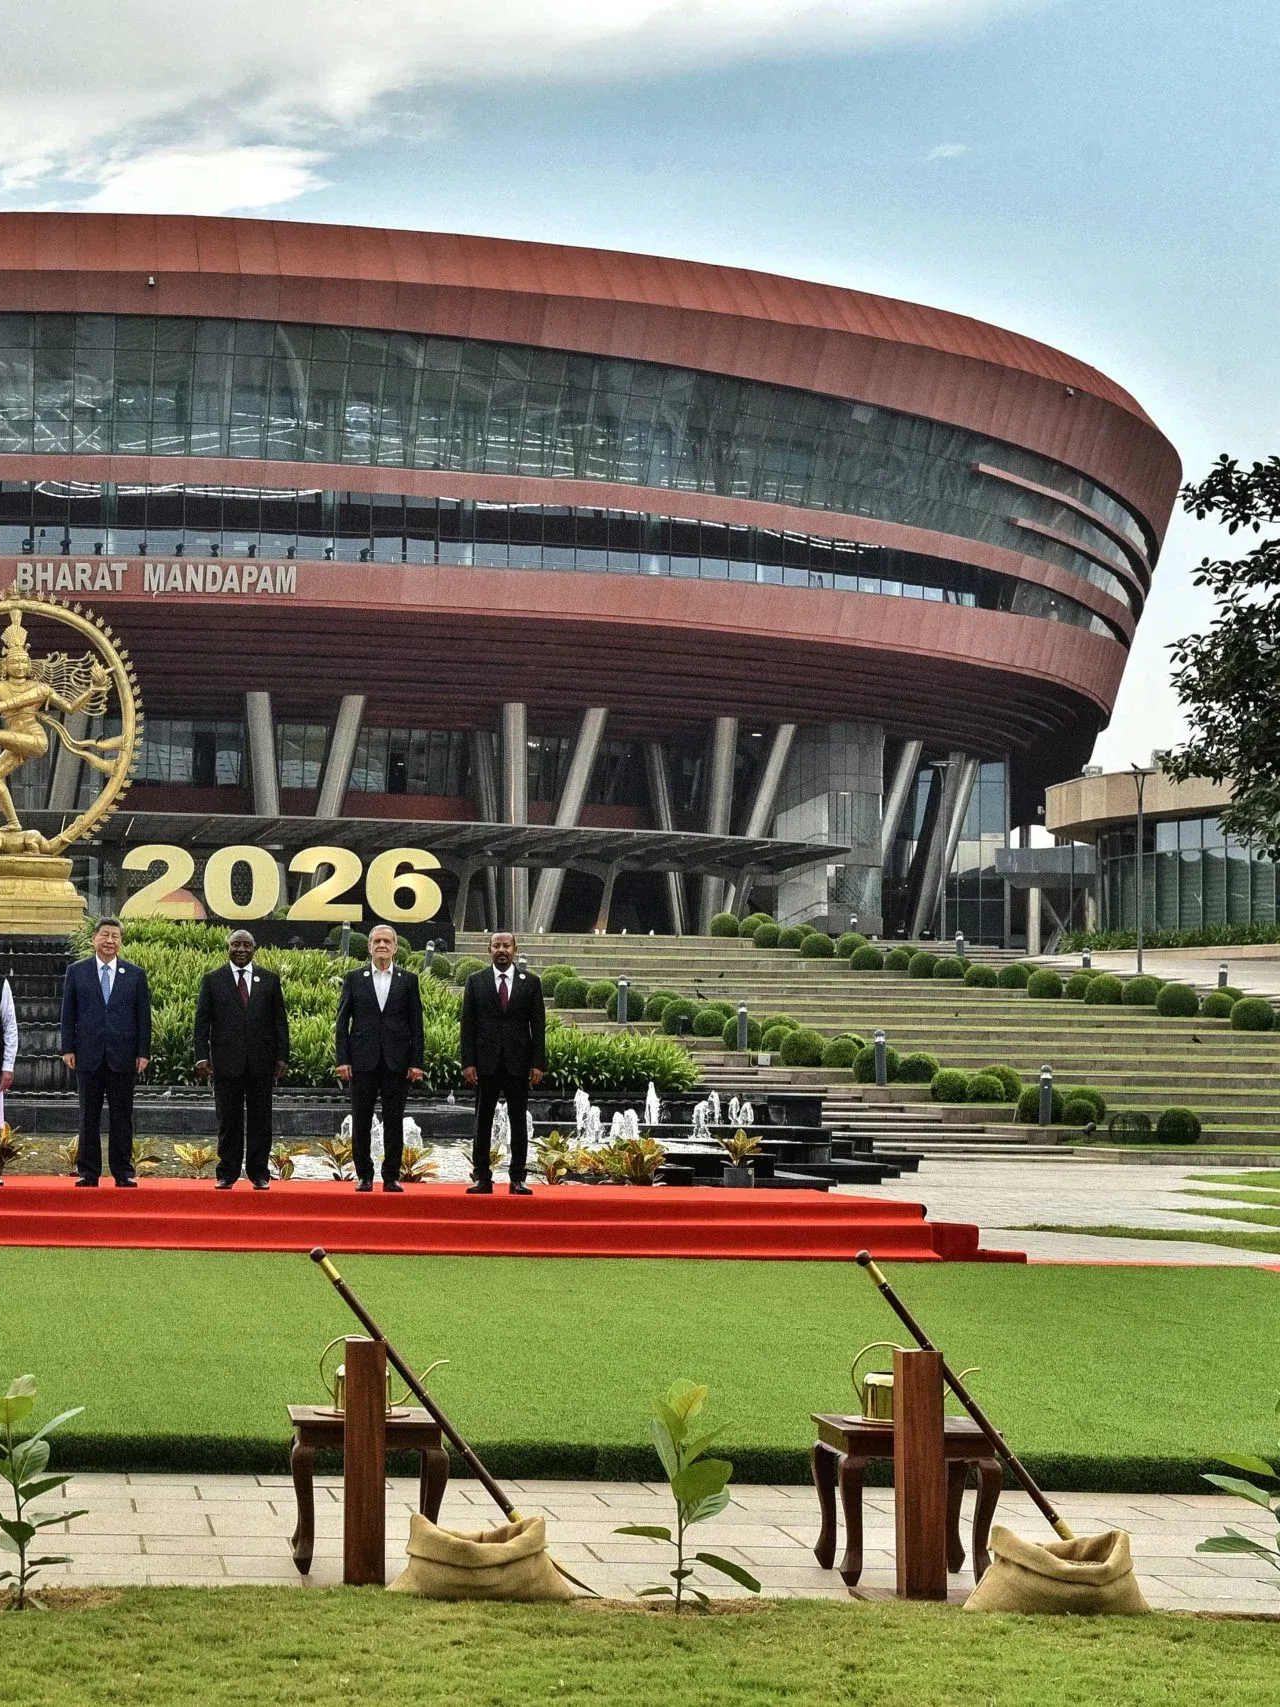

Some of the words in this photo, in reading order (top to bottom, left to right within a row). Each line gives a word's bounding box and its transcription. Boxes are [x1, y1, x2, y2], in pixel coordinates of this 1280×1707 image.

[17, 562, 128, 591] BHARAT
[143, 563, 297, 593] MANDAPAM
[120, 844, 442, 922] 2026
